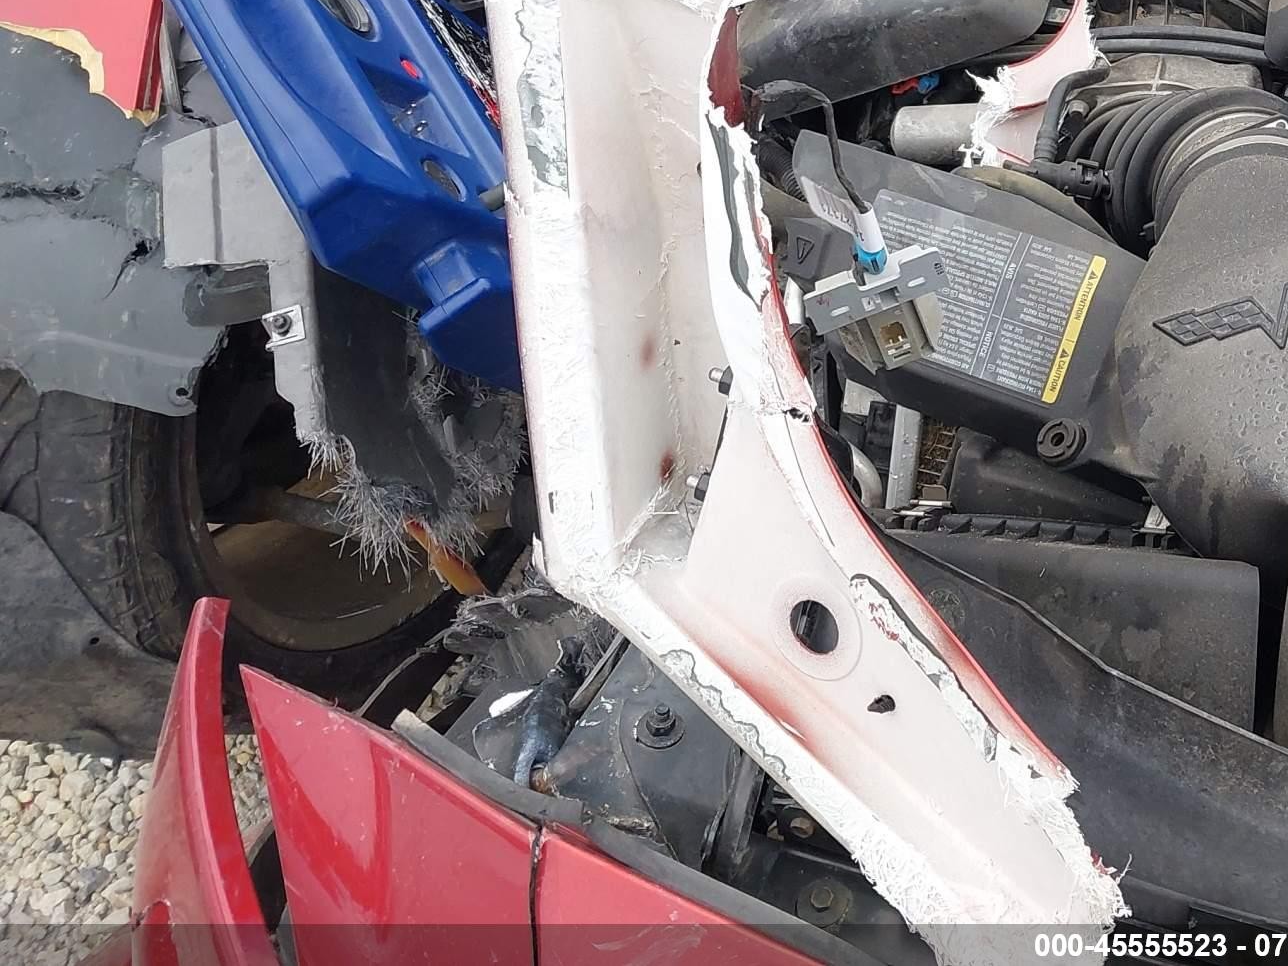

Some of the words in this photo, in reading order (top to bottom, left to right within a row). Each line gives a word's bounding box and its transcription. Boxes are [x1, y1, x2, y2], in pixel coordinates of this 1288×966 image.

[1005, 262, 1018, 280] AVIS
[1073, 279, 1094, 321] ATTENTION
[979, 331, 994, 357] NOTICE
[1049, 360, 1066, 393] CAUTION
